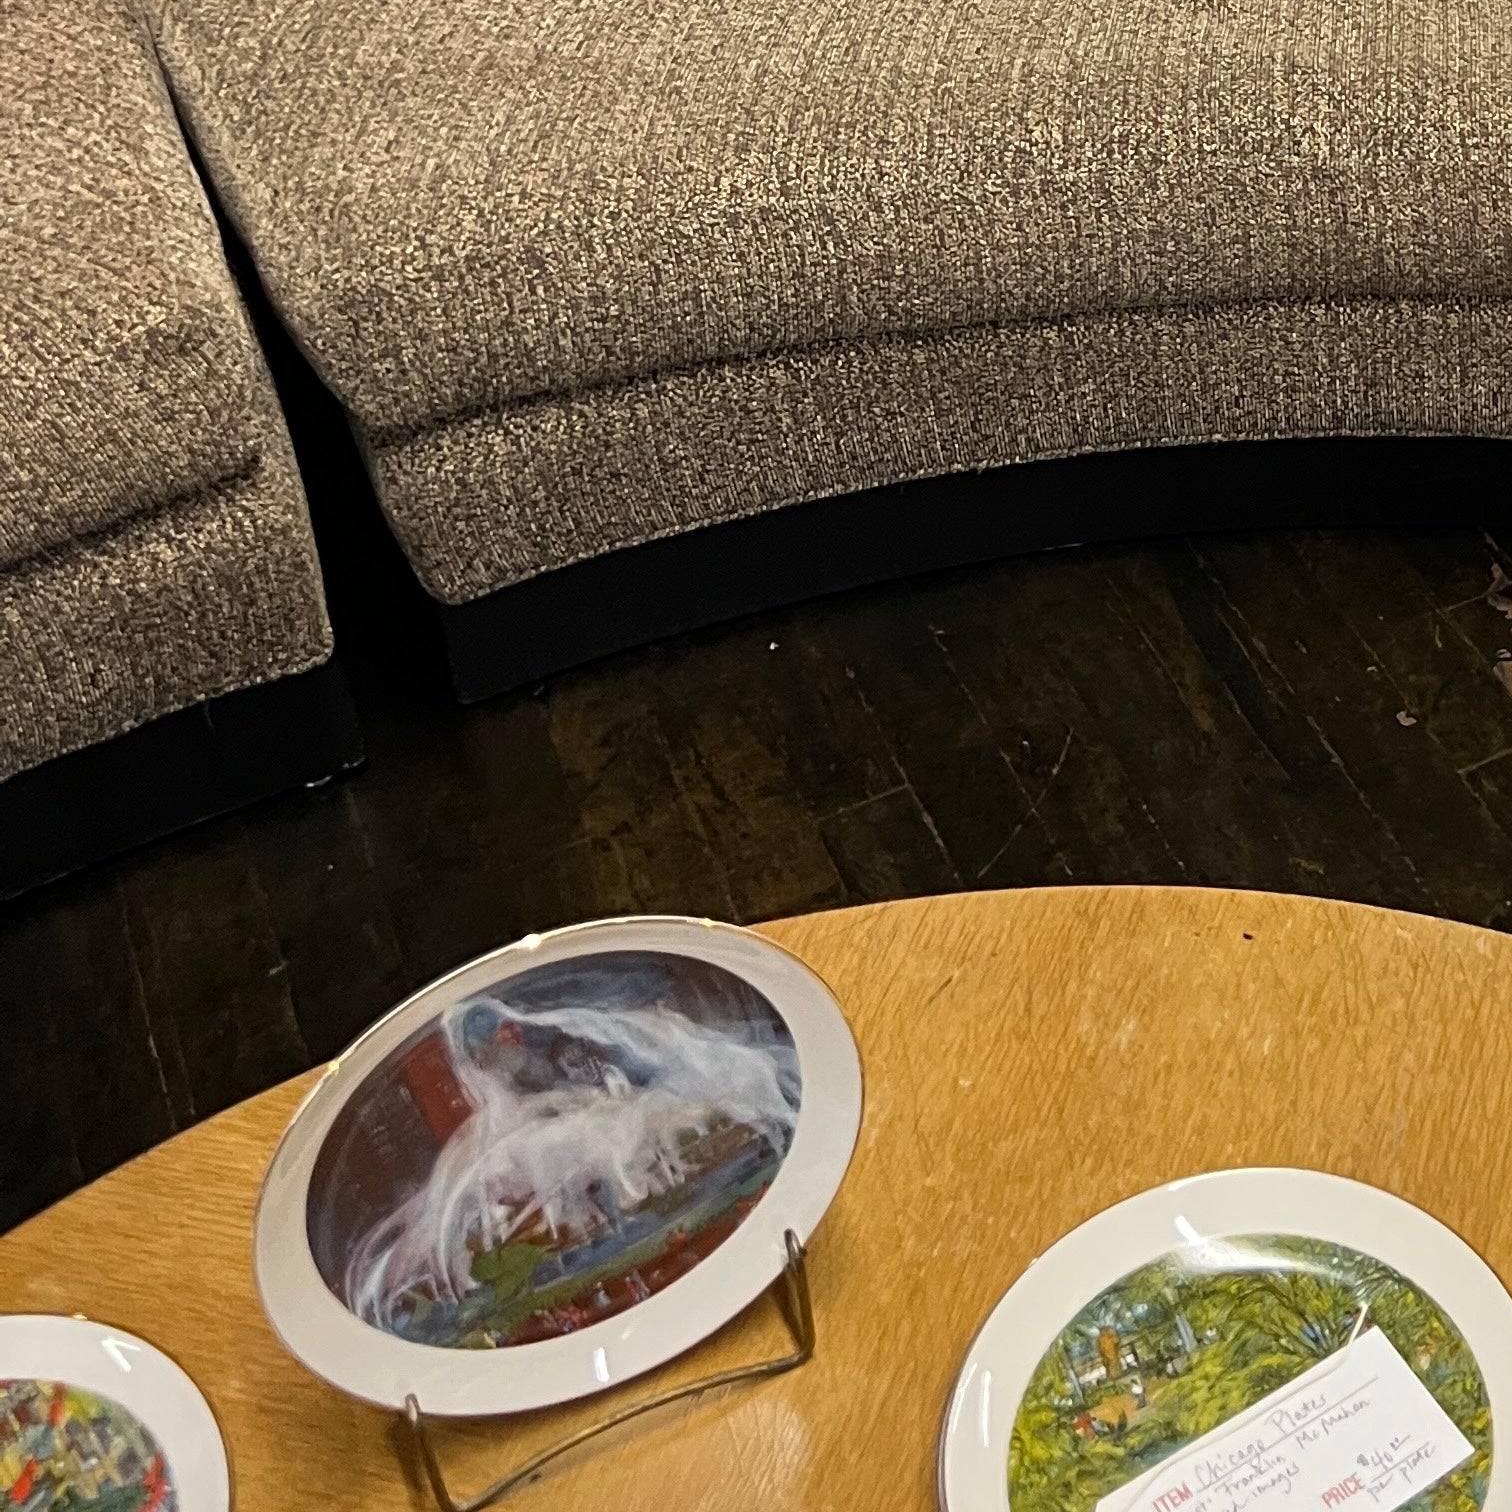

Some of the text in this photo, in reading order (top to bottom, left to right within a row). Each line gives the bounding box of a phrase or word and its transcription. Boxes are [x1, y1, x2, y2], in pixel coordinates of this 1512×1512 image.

[1152, 1480, 1194, 1512] ITEM
[1264, 1393, 1327, 1436] Plates
[1321, 1471, 1367, 1509] PRICE
